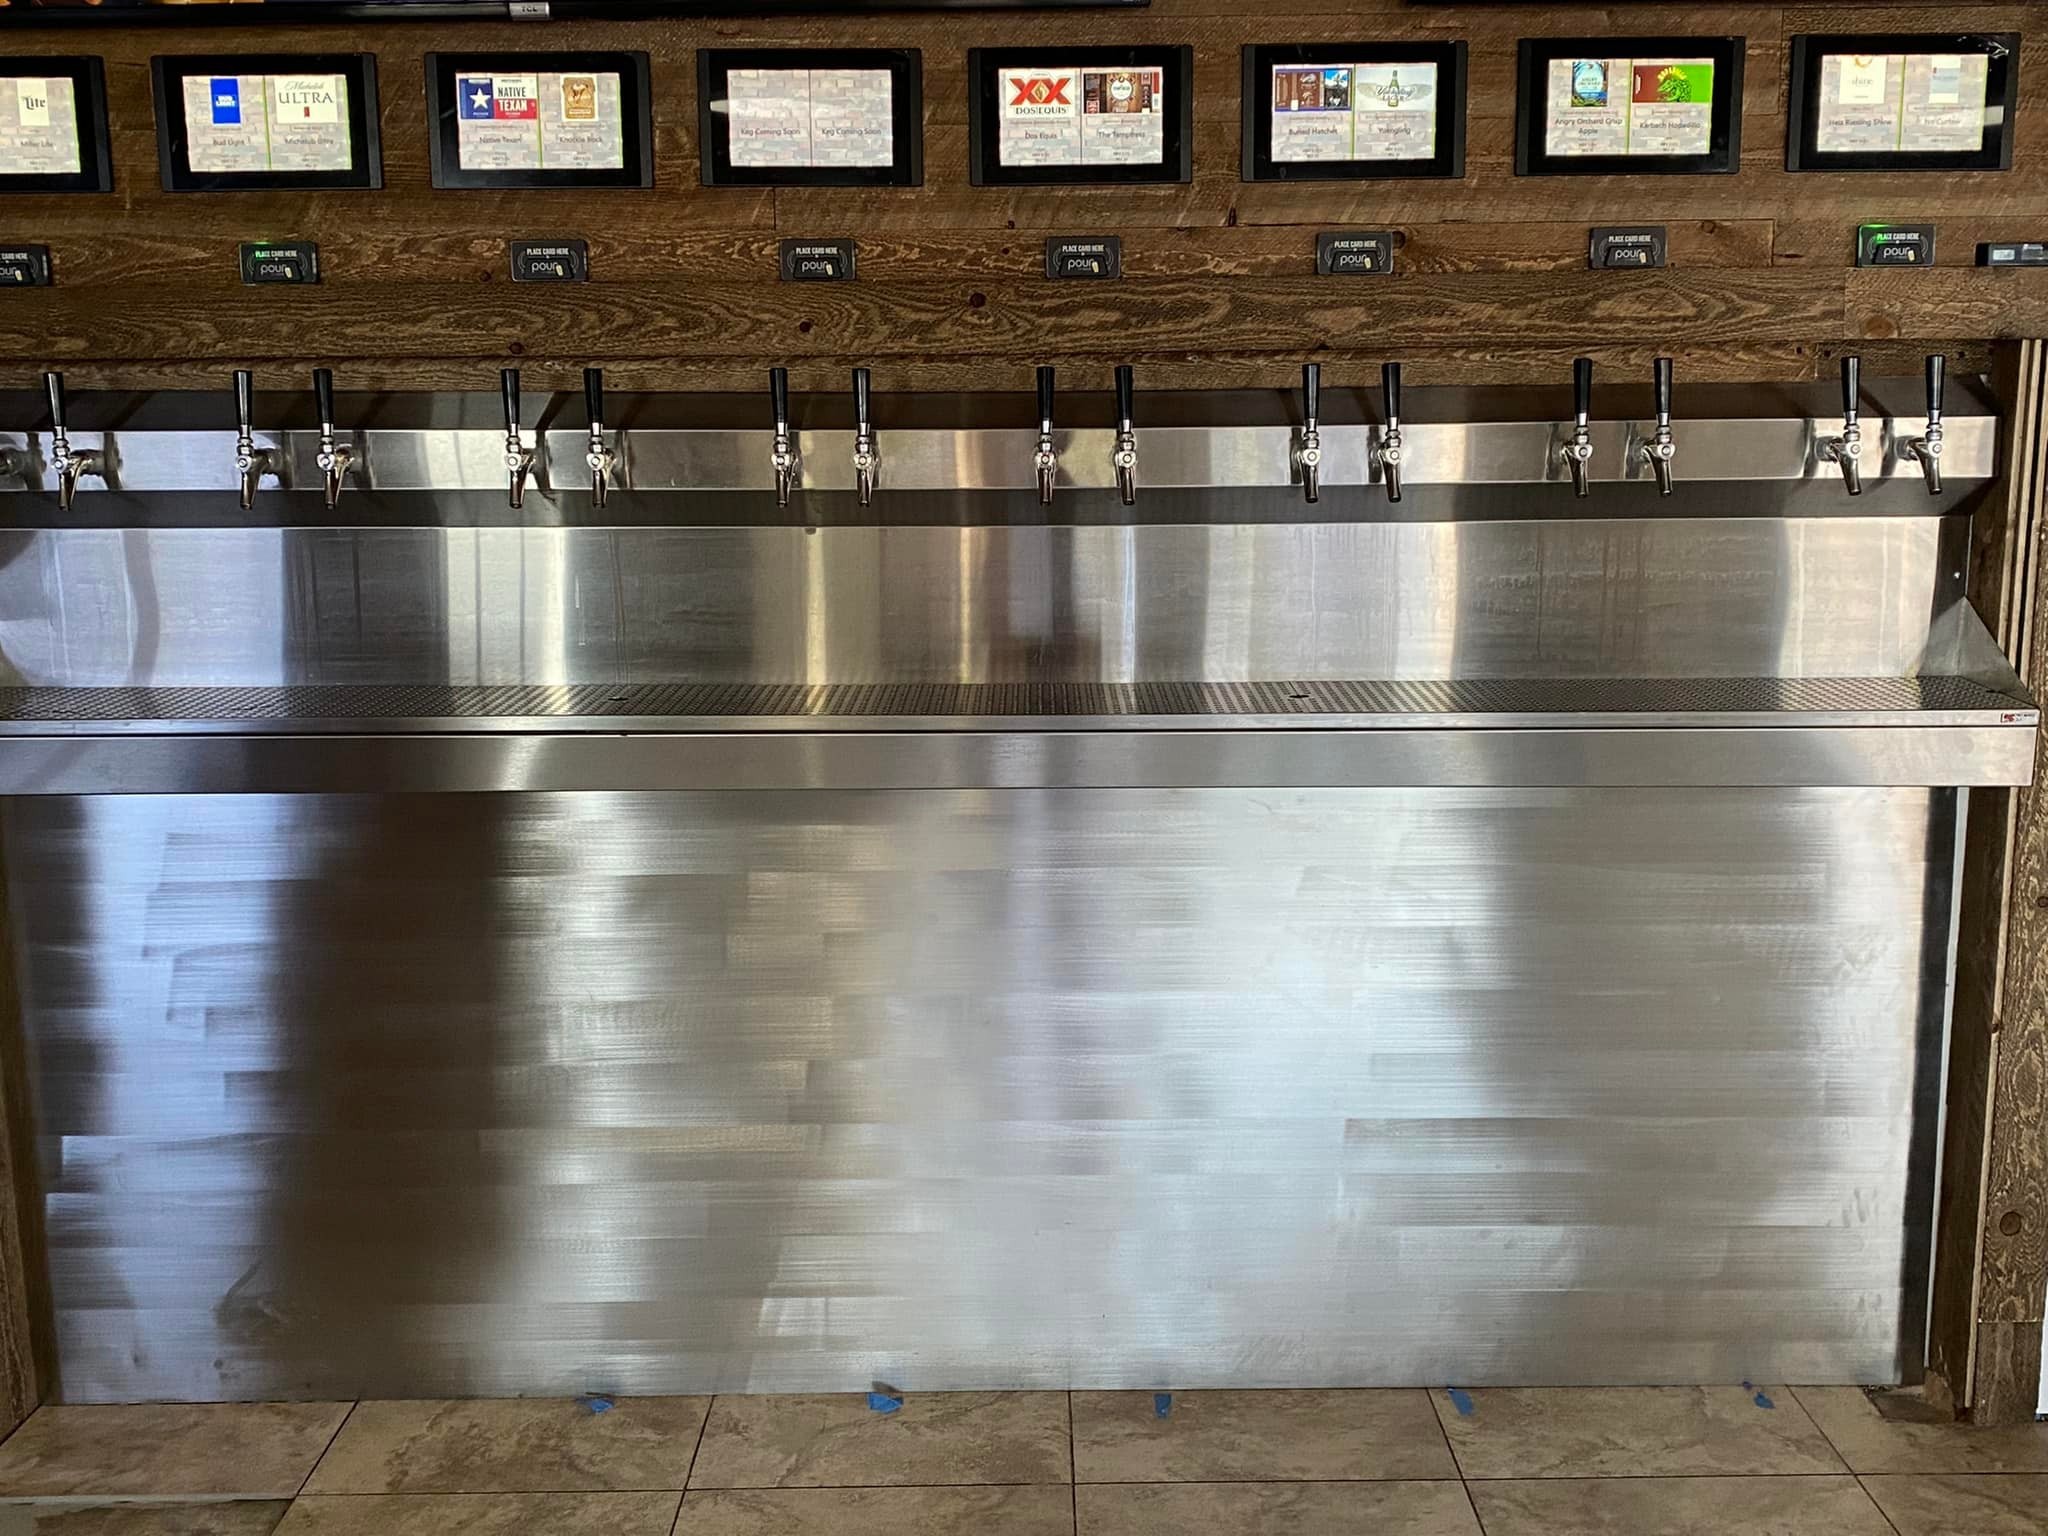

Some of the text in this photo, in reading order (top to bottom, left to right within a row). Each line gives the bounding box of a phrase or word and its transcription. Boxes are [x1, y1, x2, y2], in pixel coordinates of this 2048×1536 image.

[520, 4, 538, 13] TCL
[498, 86, 527, 98] NATIVE
[278, 92, 334, 104] ULTRA
[498, 100, 528, 112] TEXAN
[1015, 106, 1068, 115] DOS EQUIS
[1554, 118, 1576, 126] Angry
[740, 128, 754, 137] Keg
[755, 128, 782, 136] Coming
[822, 128, 835, 137] Keg
[836, 128, 863, 136] Coming
[212, 138, 228, 146] Bud
[1615, 249, 1642, 261] pour
[1883, 246, 1911, 258] pour
[1068, 258, 1094, 271] pour
[1340, 254, 1367, 266] pour
[260, 264, 287, 276] pour
[532, 262, 558, 273] pour
[802, 261, 828, 272] pour
